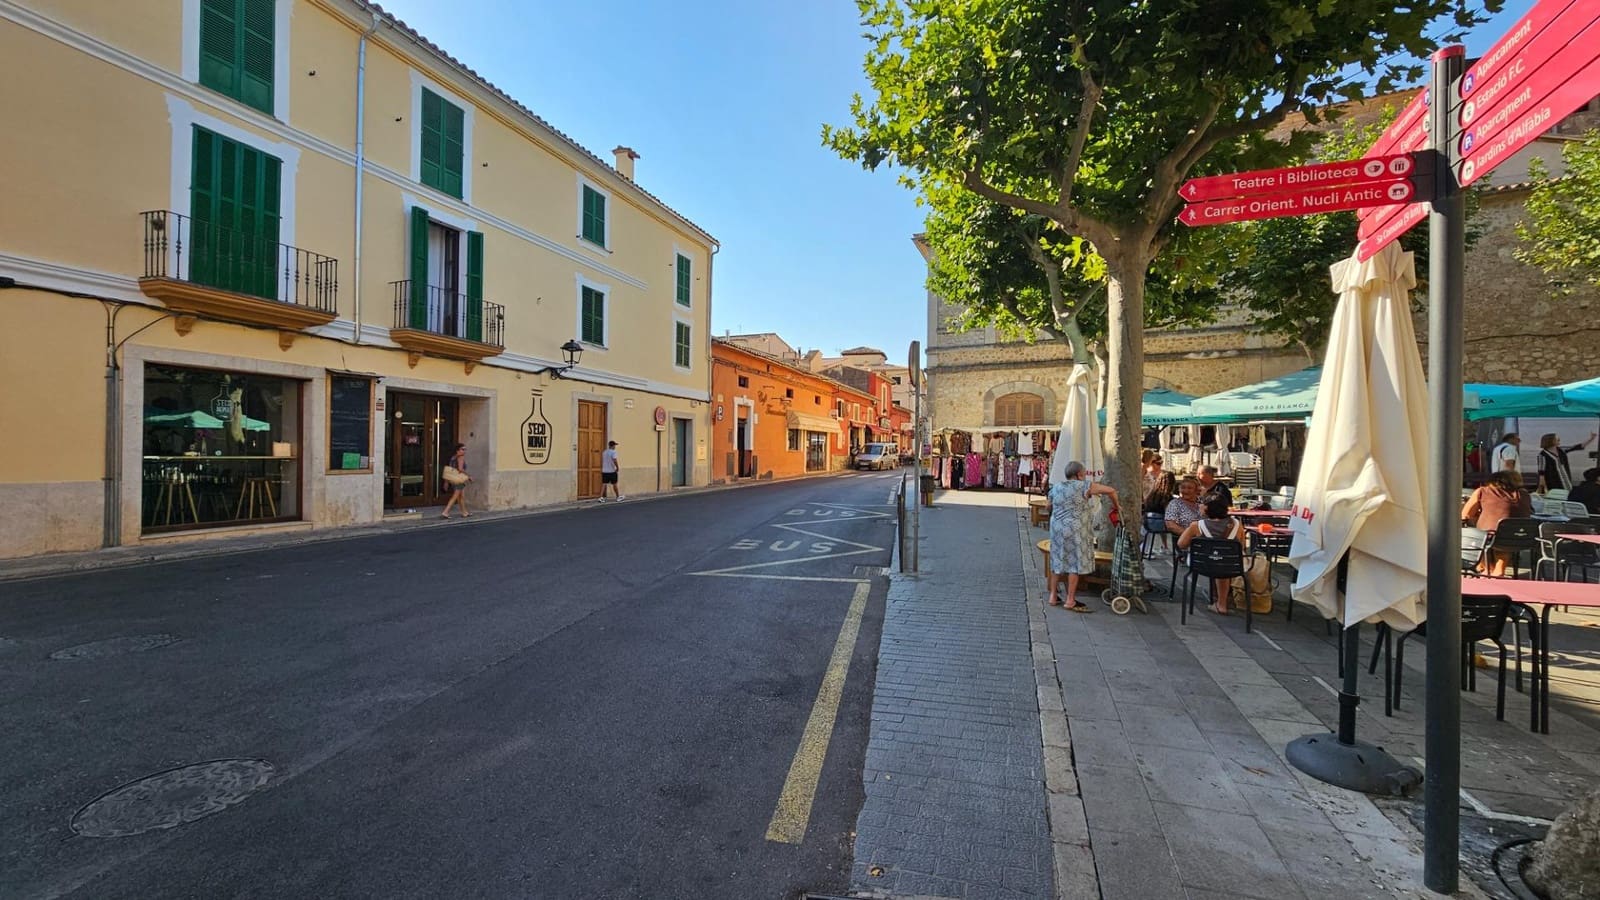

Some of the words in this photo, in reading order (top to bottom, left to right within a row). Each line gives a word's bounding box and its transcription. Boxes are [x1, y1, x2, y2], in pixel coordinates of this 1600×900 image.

[1476, 20, 1531, 79] Aparcament
[1476, 73, 1507, 109] Estació
[1476, 88, 1531, 139] Aparcament
[1476, 142, 1506, 168] Jardins
[1507, 107, 1551, 146] d'Alfàbia
[1232, 177, 1275, 189] Teatre
[1279, 174, 1283, 184] i
[1287, 167, 1358, 184] Biblioteca
[1204, 205, 1246, 218] Carrer
[1250, 199, 1298, 213] Orient.
[1303, 192, 1339, 207] Nucli
[1343, 188, 1383, 202] Antic
[527, 422, 546, 435] S'ECO
[785, 508, 857, 518] BUS
[729, 538, 838, 554] BUS
